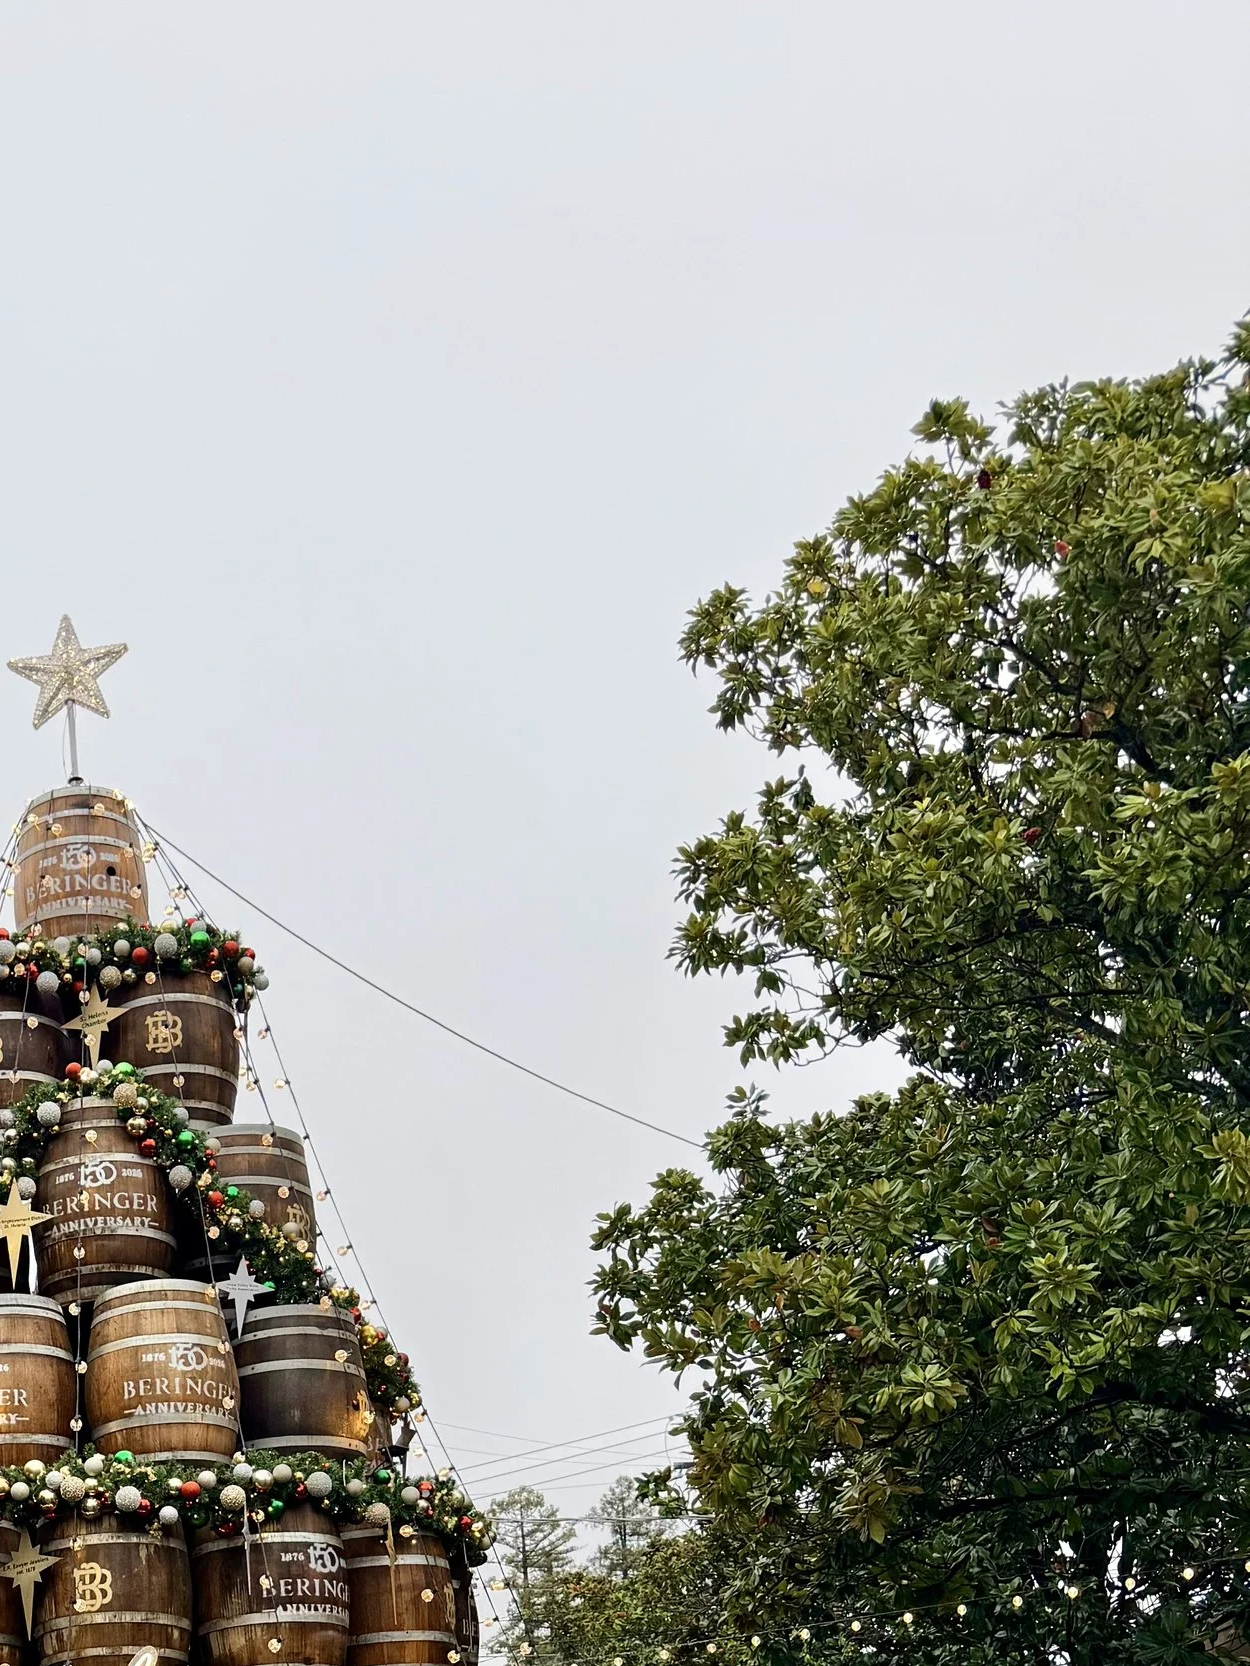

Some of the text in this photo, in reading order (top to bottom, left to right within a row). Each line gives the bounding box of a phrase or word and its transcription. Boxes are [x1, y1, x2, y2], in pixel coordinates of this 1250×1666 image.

[26, 873, 132, 904] BERINGER
[51, 1216, 152, 1238] ANNIVERSARY
[134, 1402, 231, 1419] ANNIVERSARY
[279, 1552, 305, 1562] 1876
